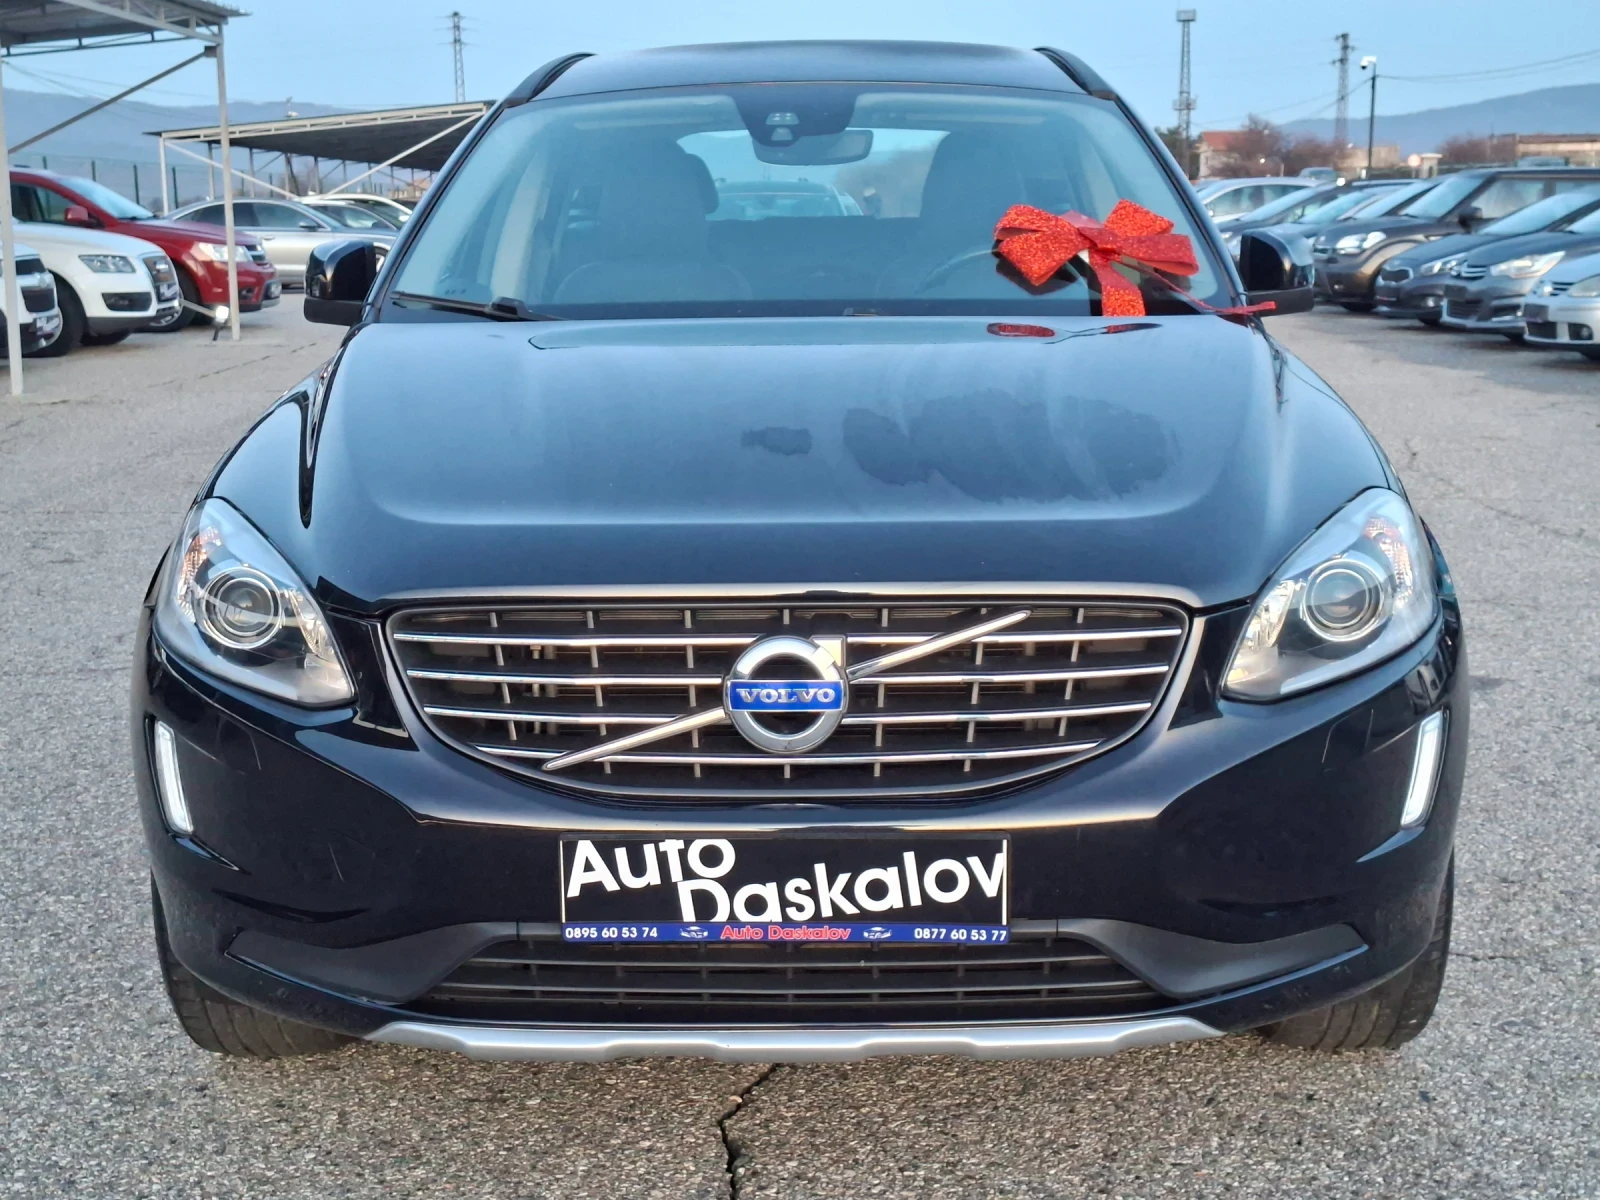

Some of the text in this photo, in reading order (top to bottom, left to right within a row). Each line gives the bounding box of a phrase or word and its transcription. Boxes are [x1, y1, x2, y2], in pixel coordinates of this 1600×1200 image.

[736, 688, 836, 703] VOLVO
[566, 838, 736, 898] Auto
[676, 850, 1005, 922] Daskalov
[565, 927, 658, 938] 0895 60 53 74
[720, 925, 852, 940] Auto Daskalov
[914, 927, 1007, 941] 0877 60 53 77
